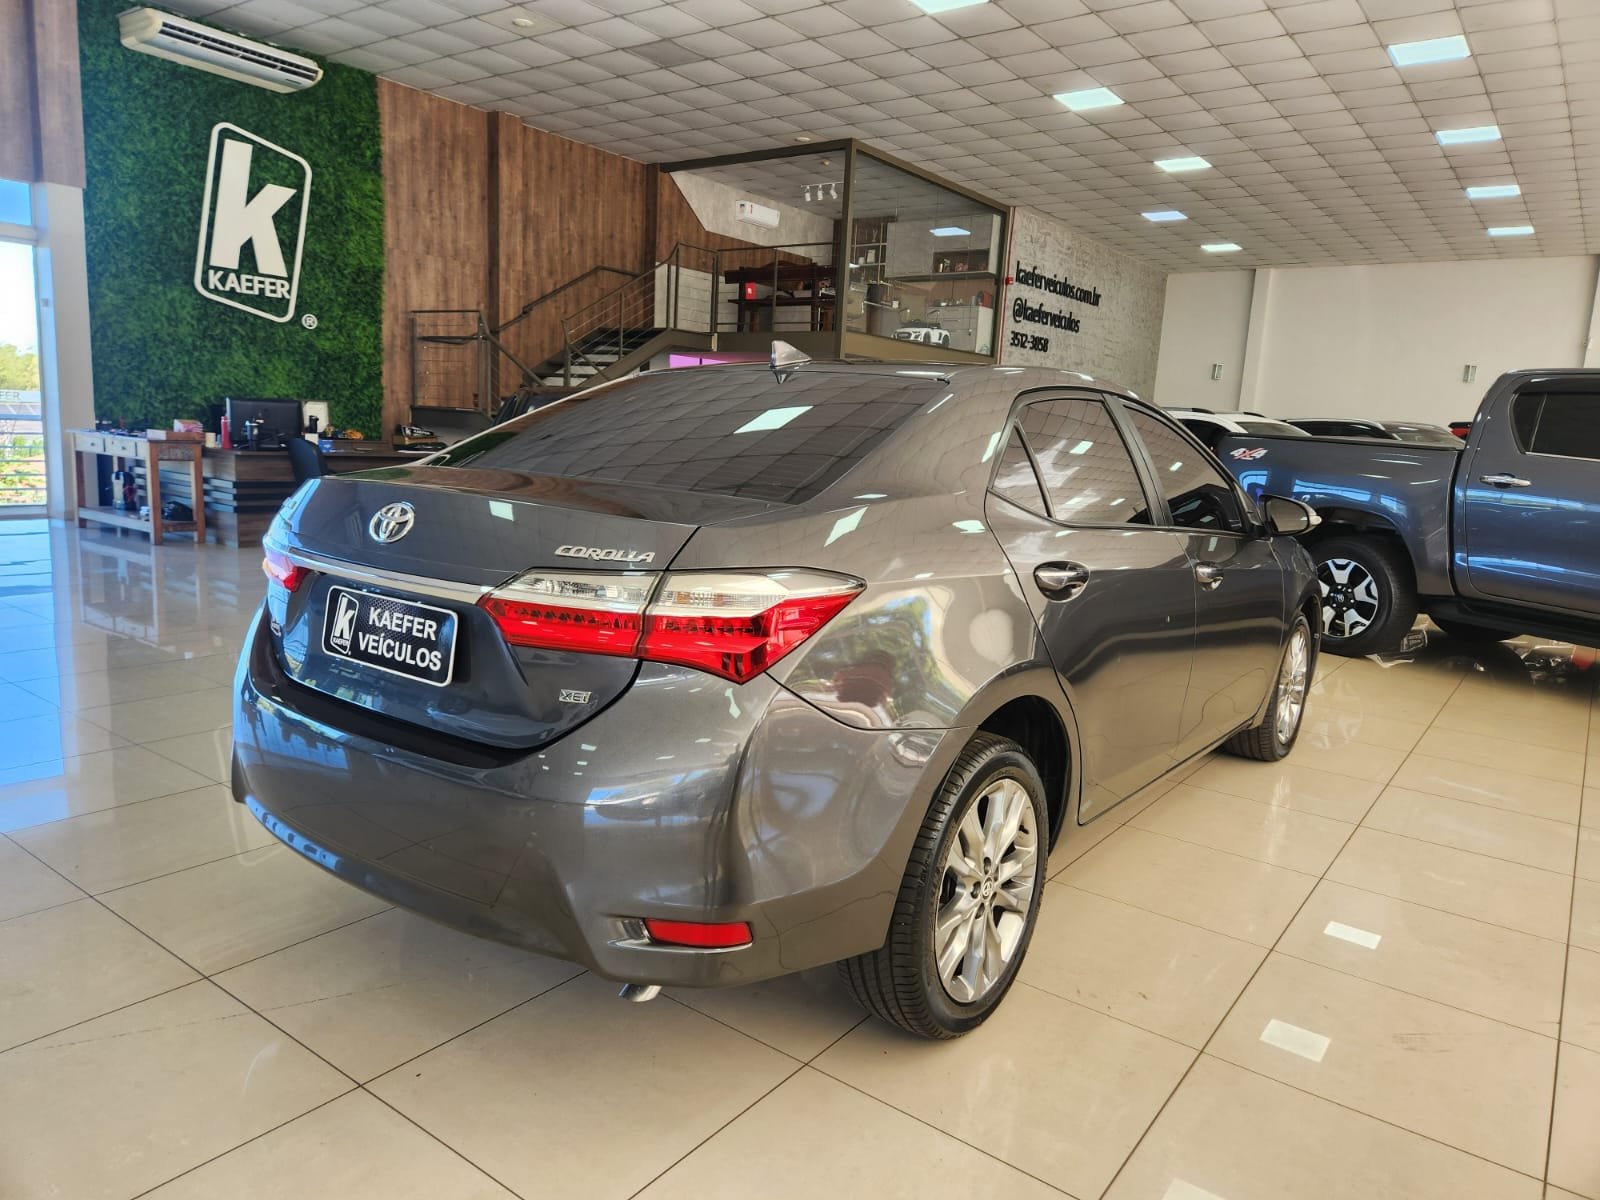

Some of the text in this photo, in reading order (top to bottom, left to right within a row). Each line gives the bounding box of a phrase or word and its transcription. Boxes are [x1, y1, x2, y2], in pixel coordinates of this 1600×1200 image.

[208, 269, 291, 300] KAEFER
[1013, 297, 1080, 333] @kaeferveiculos
[554, 545, 655, 563] COROLLA
[368, 606, 438, 641] KAEFER
[358, 631, 442, 672] VEÍCULOS
